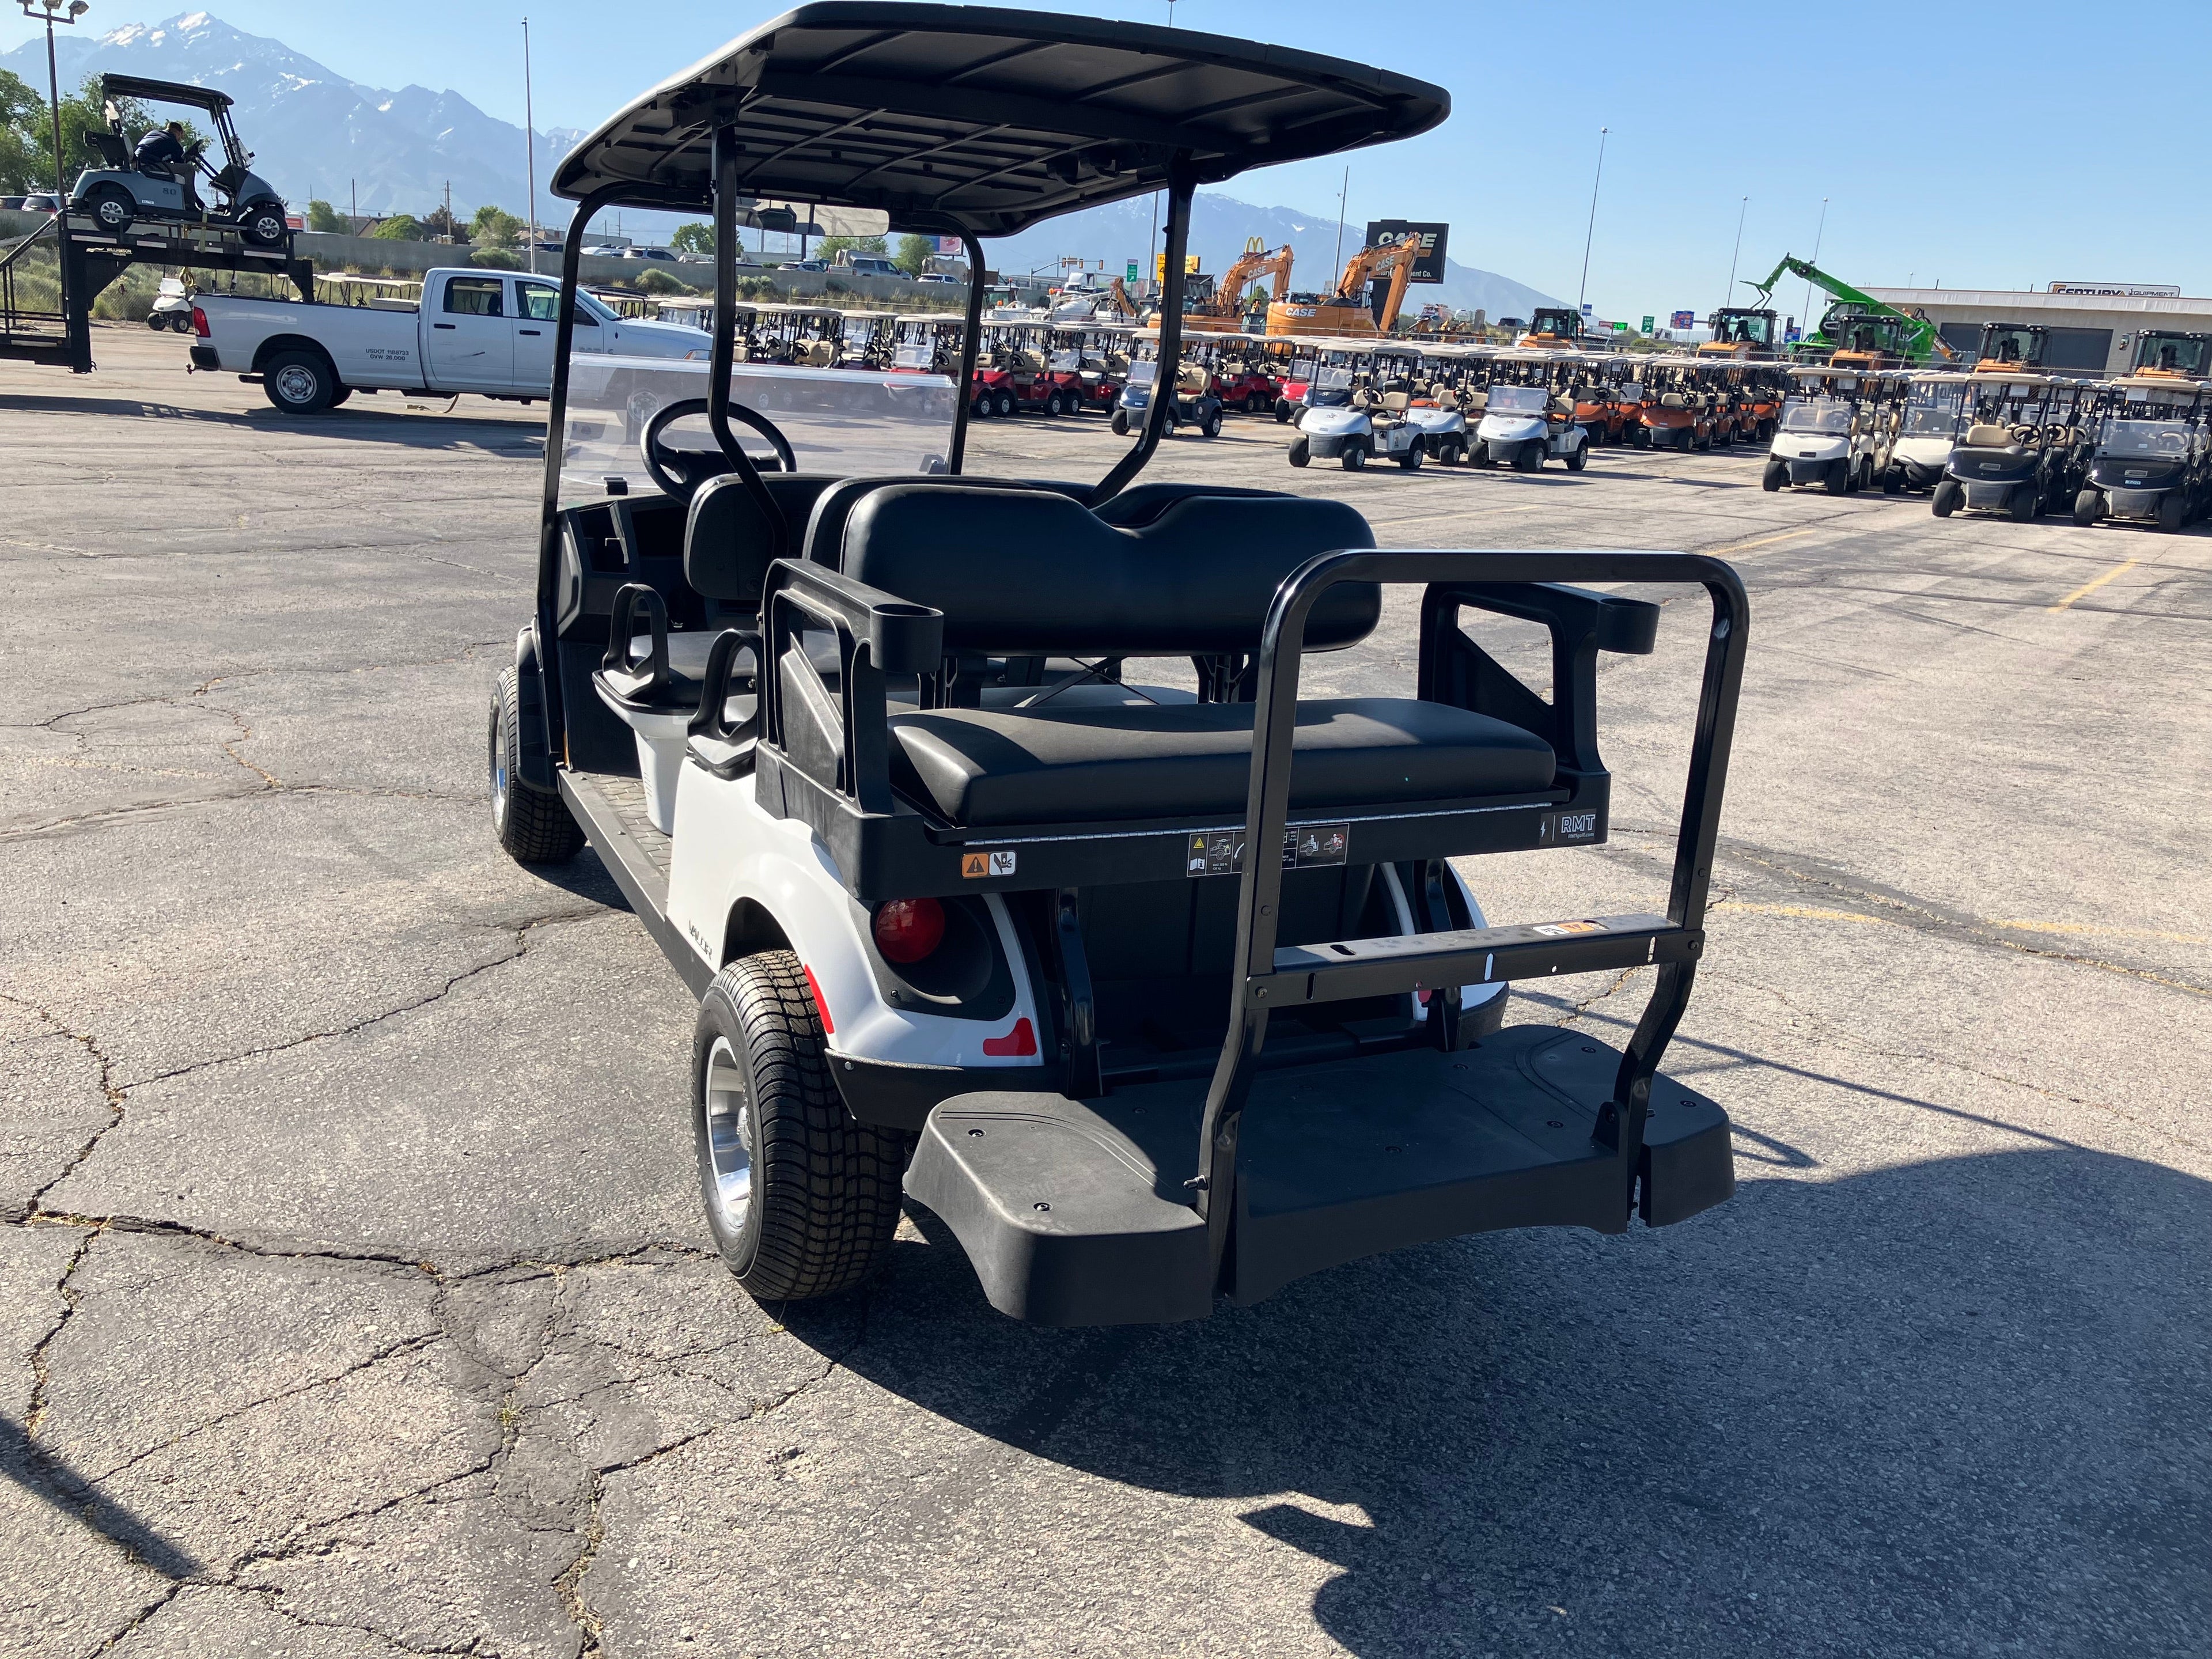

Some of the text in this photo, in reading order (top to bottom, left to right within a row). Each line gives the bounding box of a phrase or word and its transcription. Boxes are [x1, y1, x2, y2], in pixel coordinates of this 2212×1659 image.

[1378, 232, 1438, 248] CAE
[1376, 255, 1395, 272] CASE
[1248, 266, 1267, 279] CASE
[1285, 307, 1317, 317] CASE
[1560, 813, 1596, 834] RMT
